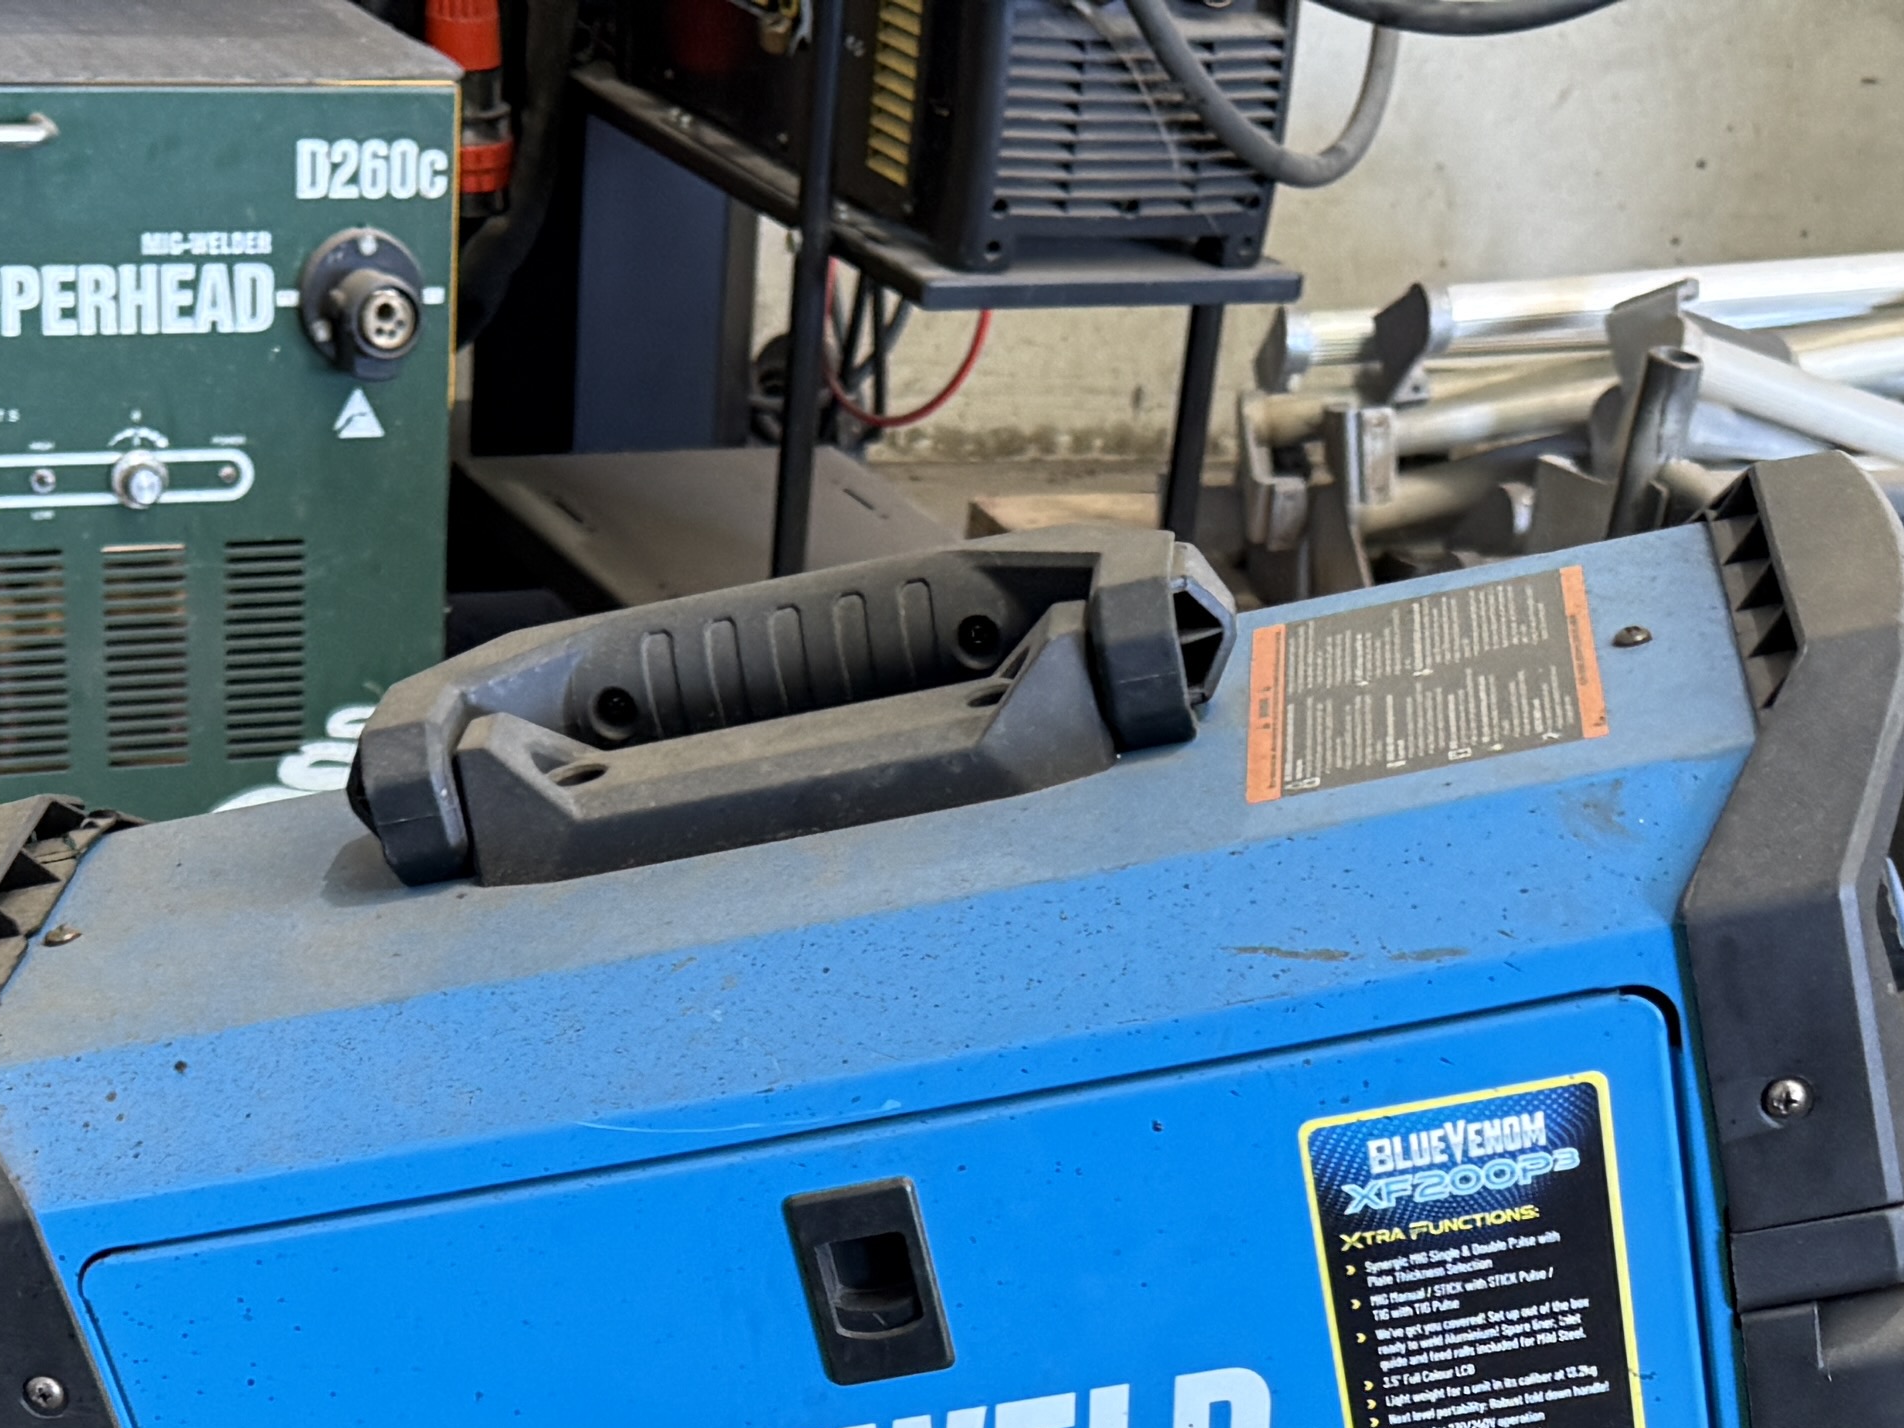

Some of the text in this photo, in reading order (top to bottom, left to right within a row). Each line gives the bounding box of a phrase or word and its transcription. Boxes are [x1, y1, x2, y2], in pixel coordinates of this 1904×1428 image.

[141, 231, 272, 256] MIG-WELDER
[1433, 1281, 1463, 1296] STICK
[1488, 1272, 1517, 1287] STICK
